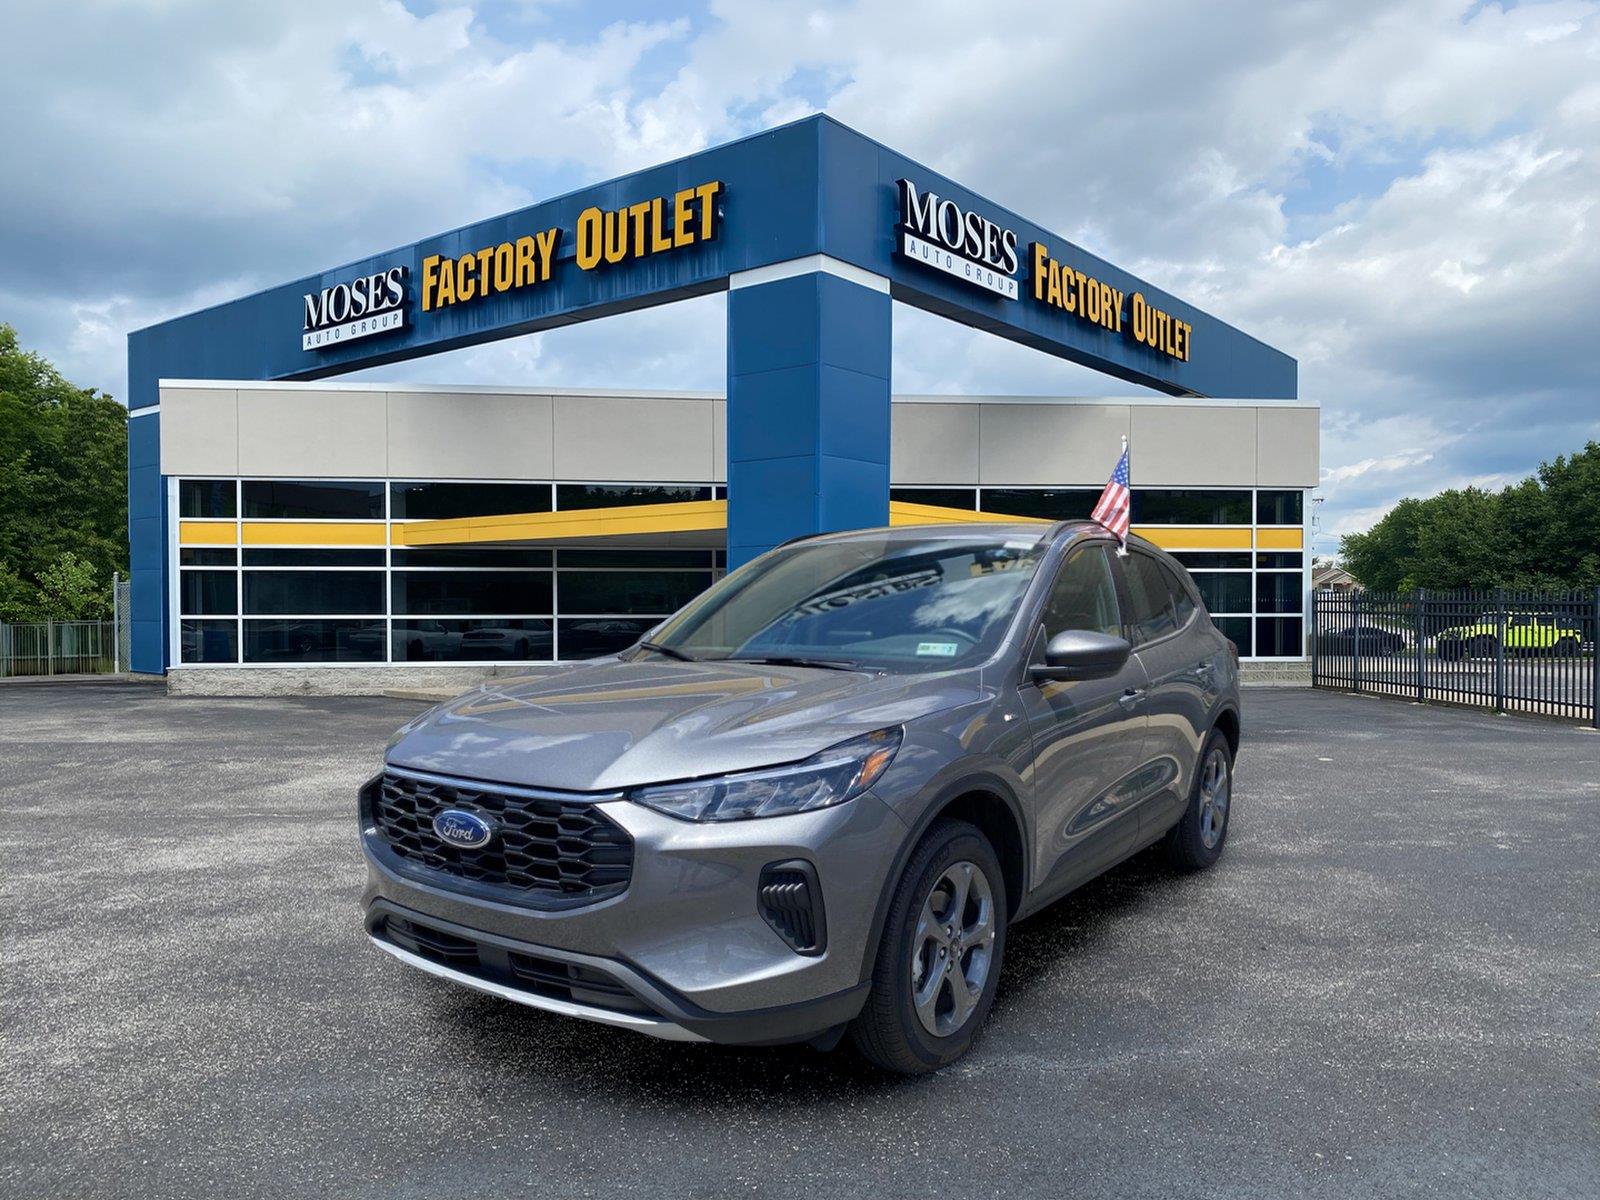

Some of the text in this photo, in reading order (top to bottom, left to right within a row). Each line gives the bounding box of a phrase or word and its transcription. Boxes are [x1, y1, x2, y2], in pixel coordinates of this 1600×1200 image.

[903, 178, 1018, 275] MOSES
[910, 239, 1014, 294] AUTO GROUP
[303, 267, 403, 330] MOSES
[307, 313, 399, 347] AUTO GROUP
[443, 817, 474, 841] Ford
